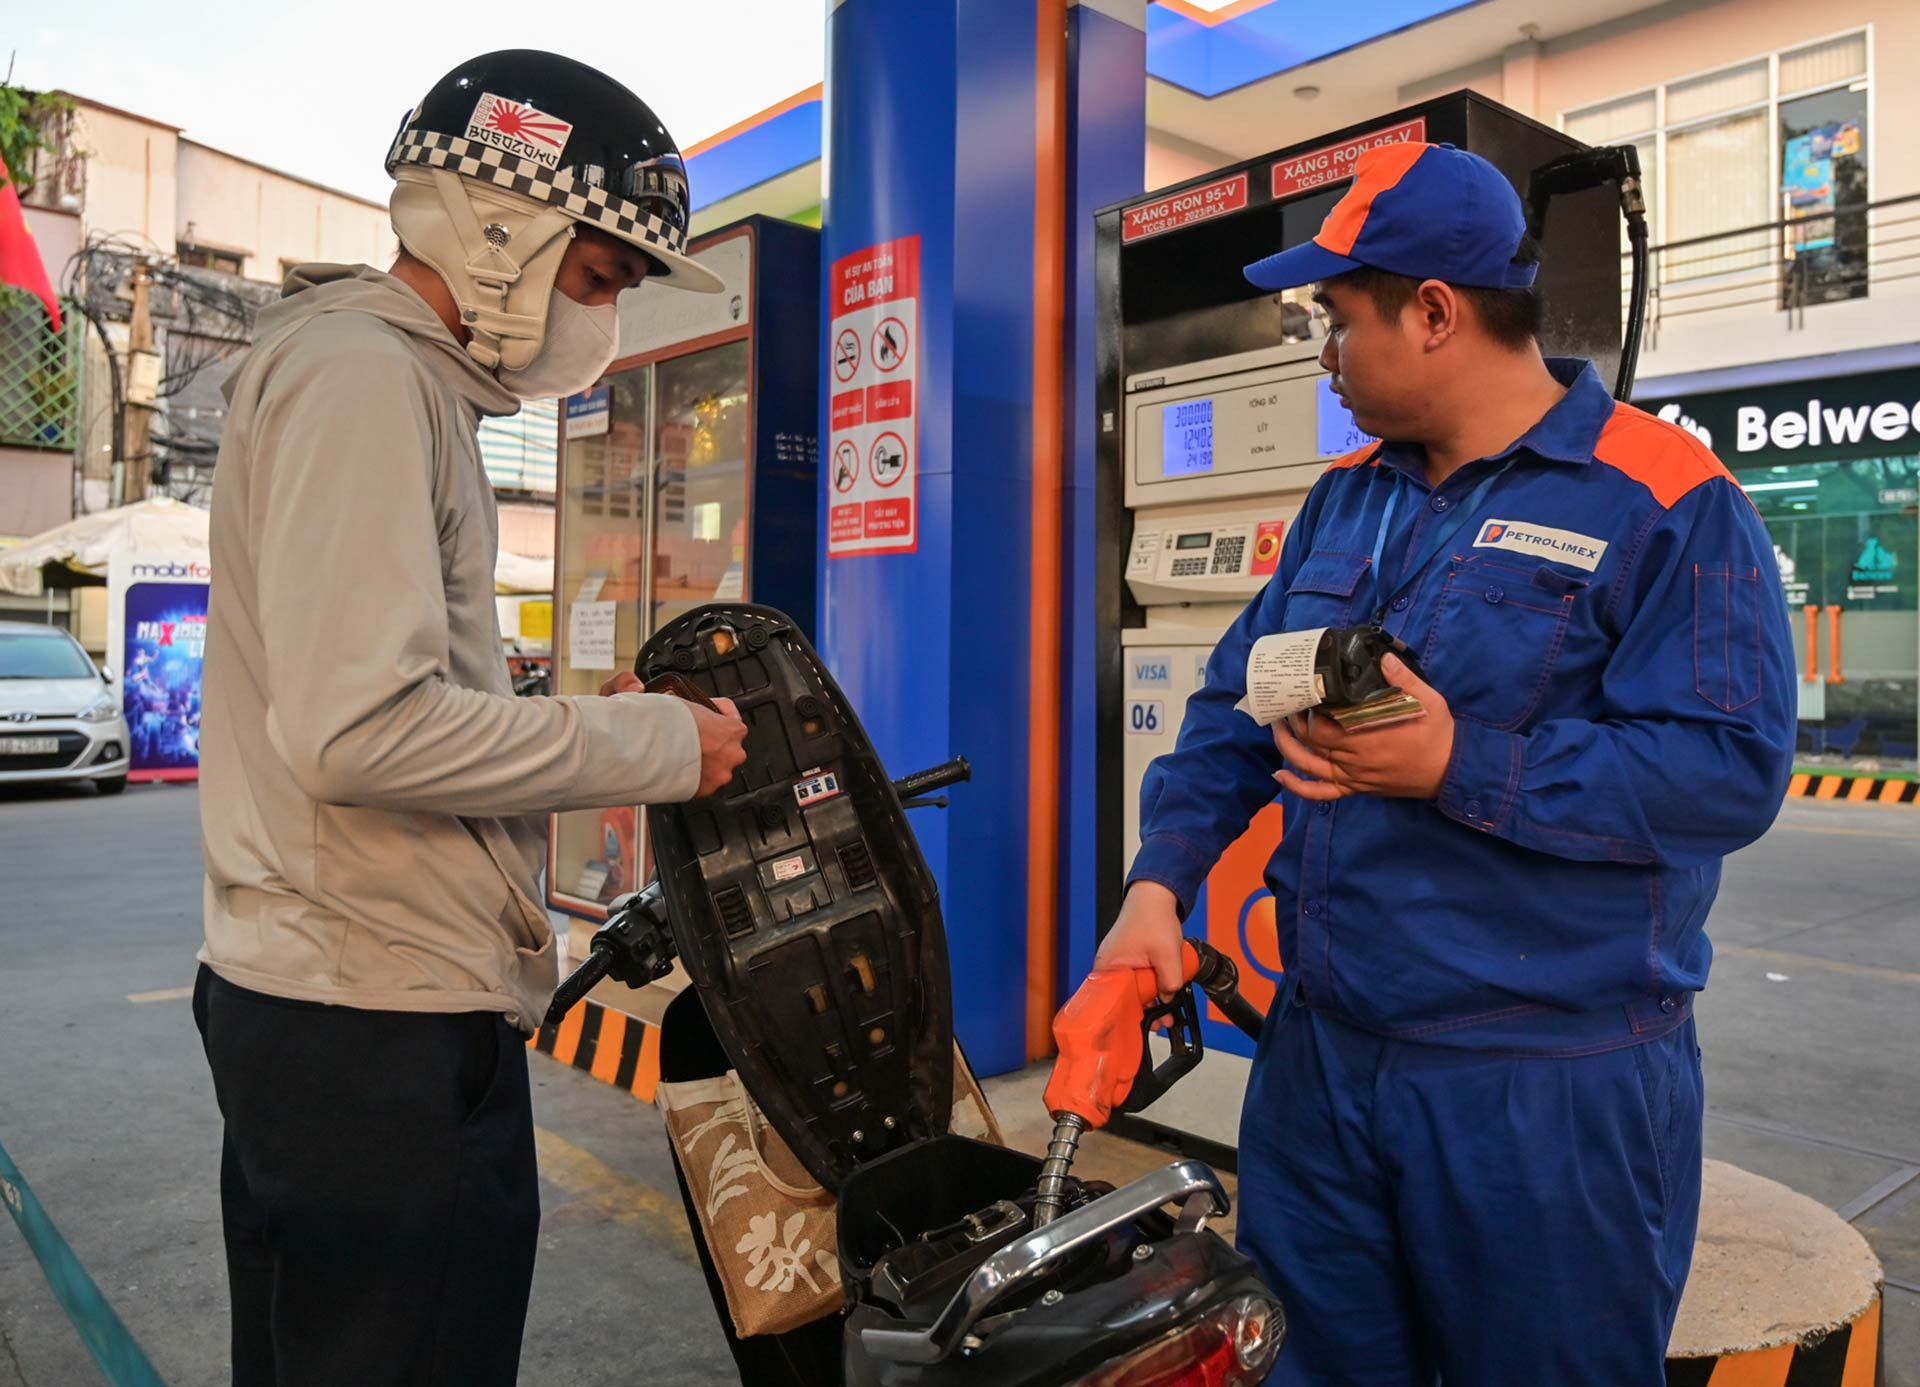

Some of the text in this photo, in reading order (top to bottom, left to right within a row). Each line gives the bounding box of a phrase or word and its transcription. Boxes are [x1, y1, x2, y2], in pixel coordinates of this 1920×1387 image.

[468, 125, 558, 167] BOSOZOKU
[1284, 155, 1328, 180] XĂNG
[1333, 142, 1369, 164] RON
[1296, 173, 1324, 188] TCCS
[1326, 169, 1338, 180] 01
[1132, 183, 1236, 226] XĂNG RON 95-V
[1142, 220, 1165, 234] TCCS
[1167, 216, 1177, 227] 01
[1184, 202, 1225, 222] 2023/PLX
[862, 261, 873, 273] AN
[844, 275, 894, 306] CỦA BẠN
[1175, 401, 1212, 428] 300000
[1737, 399, 1920, 452] Belwe
[1506, 530, 1598, 559] PETROLIMEX
[1135, 664, 1168, 680] VISA
[1132, 704, 1157, 730] 06
